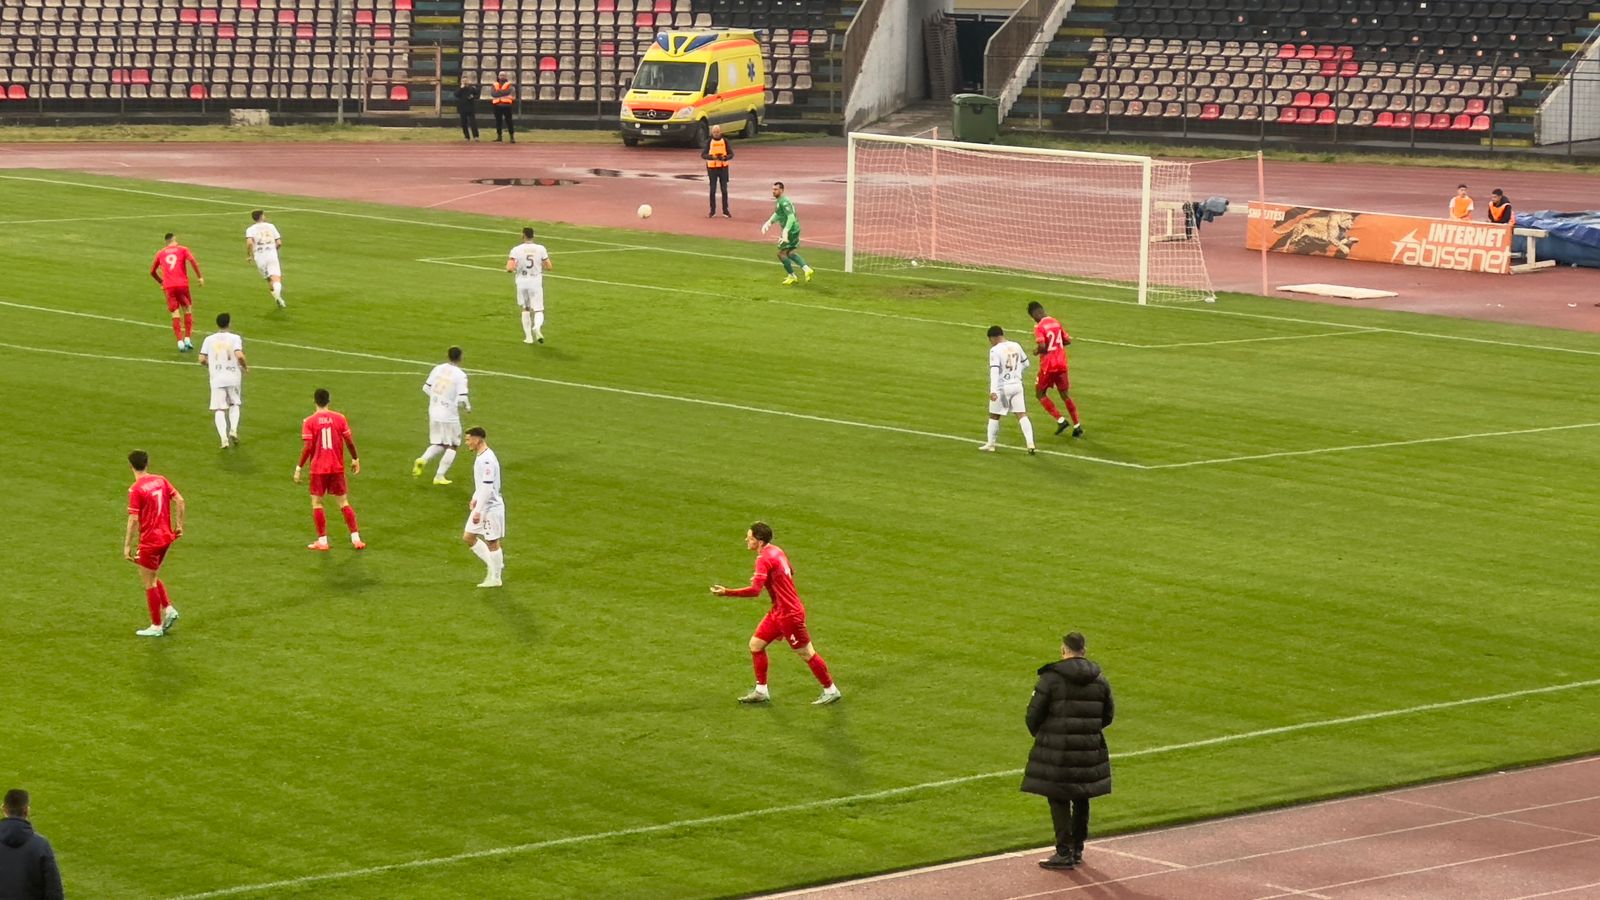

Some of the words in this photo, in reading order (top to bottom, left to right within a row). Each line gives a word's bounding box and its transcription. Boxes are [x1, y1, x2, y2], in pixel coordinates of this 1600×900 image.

[1428, 223, 1506, 248] INTERNET
[165, 254, 177, 271] 9
[526, 254, 534, 269] 5
[1403, 238, 1511, 274] abissnet
[1046, 329, 1064, 352] 24
[1005, 352, 1019, 372] 47
[321, 427, 333, 450] 11
[152, 488, 163, 516] 7
